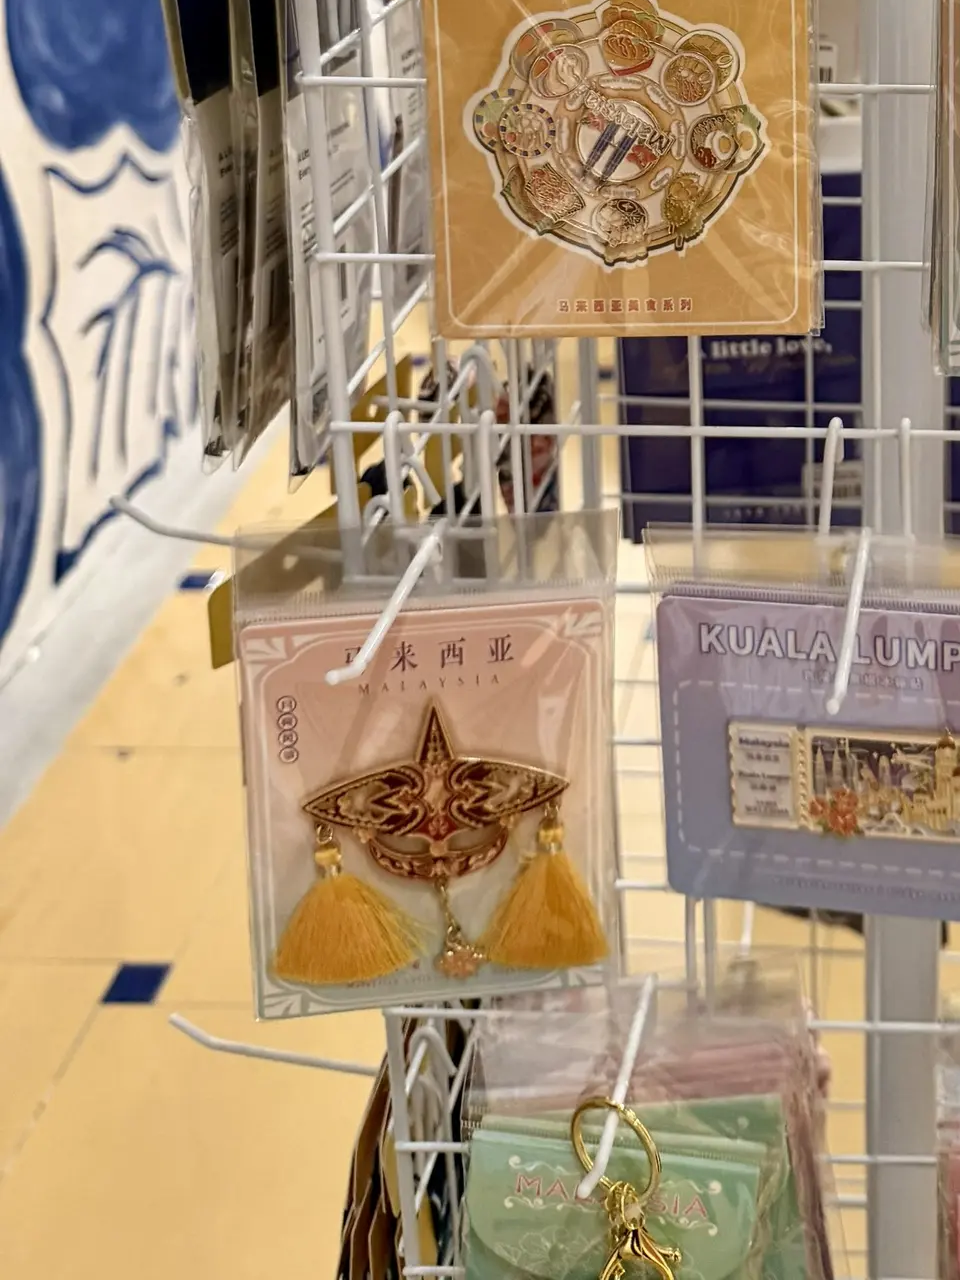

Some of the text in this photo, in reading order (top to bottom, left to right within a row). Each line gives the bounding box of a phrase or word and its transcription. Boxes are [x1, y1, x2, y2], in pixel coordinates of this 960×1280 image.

[710, 338, 773, 359] little
[698, 622, 837, 662] KUALA
[358, 673, 500, 696] MALAYSIA
